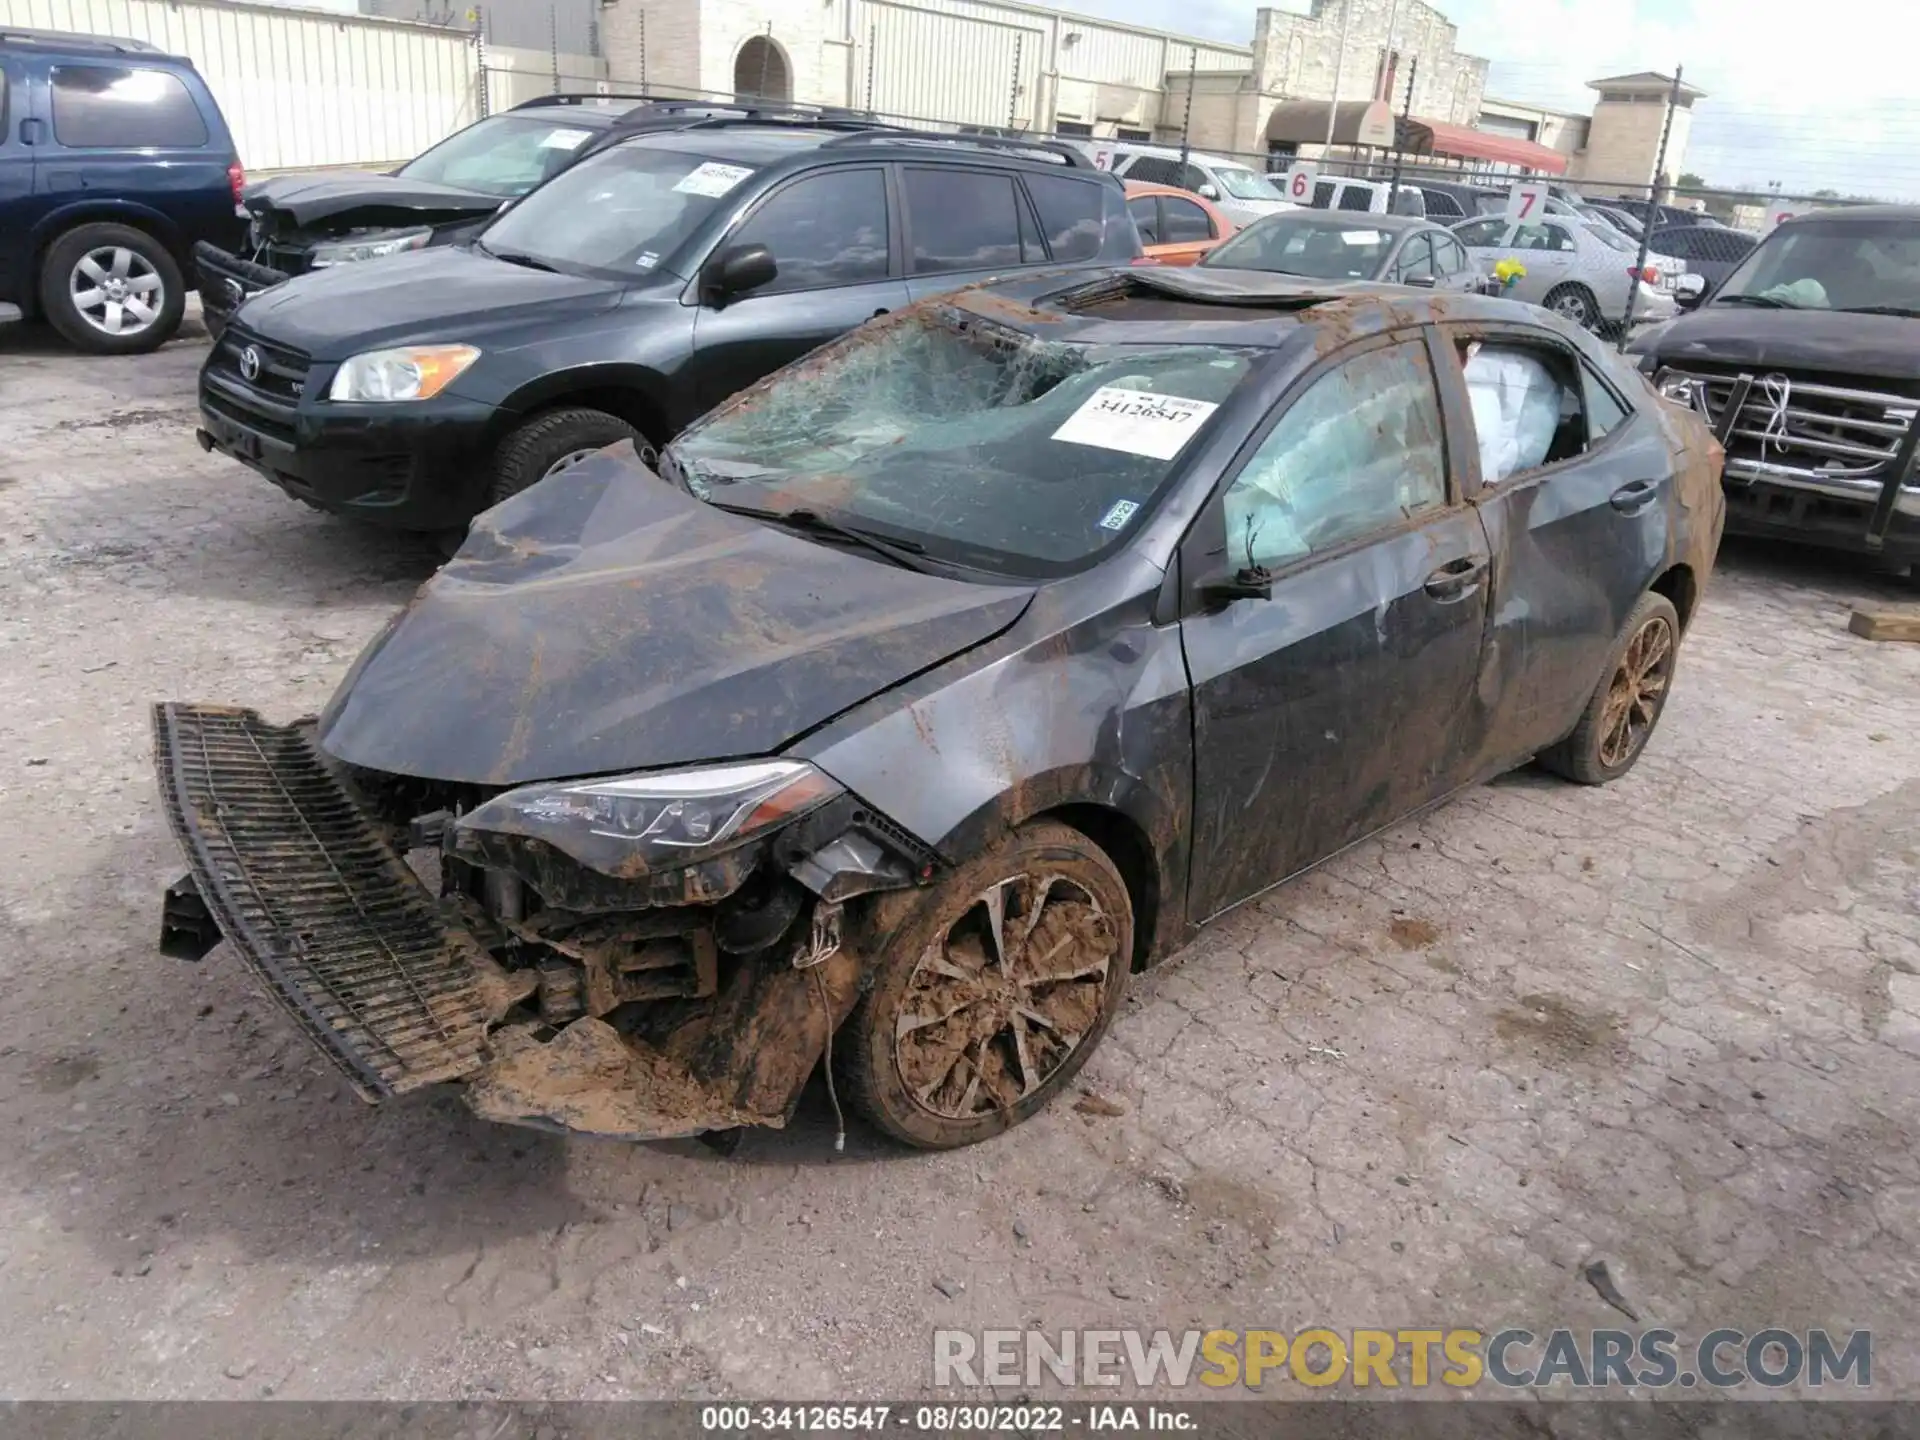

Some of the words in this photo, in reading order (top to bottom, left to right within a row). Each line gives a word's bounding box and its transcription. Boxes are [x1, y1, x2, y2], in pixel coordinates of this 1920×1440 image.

[1095, 151, 1108, 170] 5
[1292, 172, 1307, 197] 6
[1518, 192, 1536, 219] 7
[1093, 400, 1193, 423] 34126547
